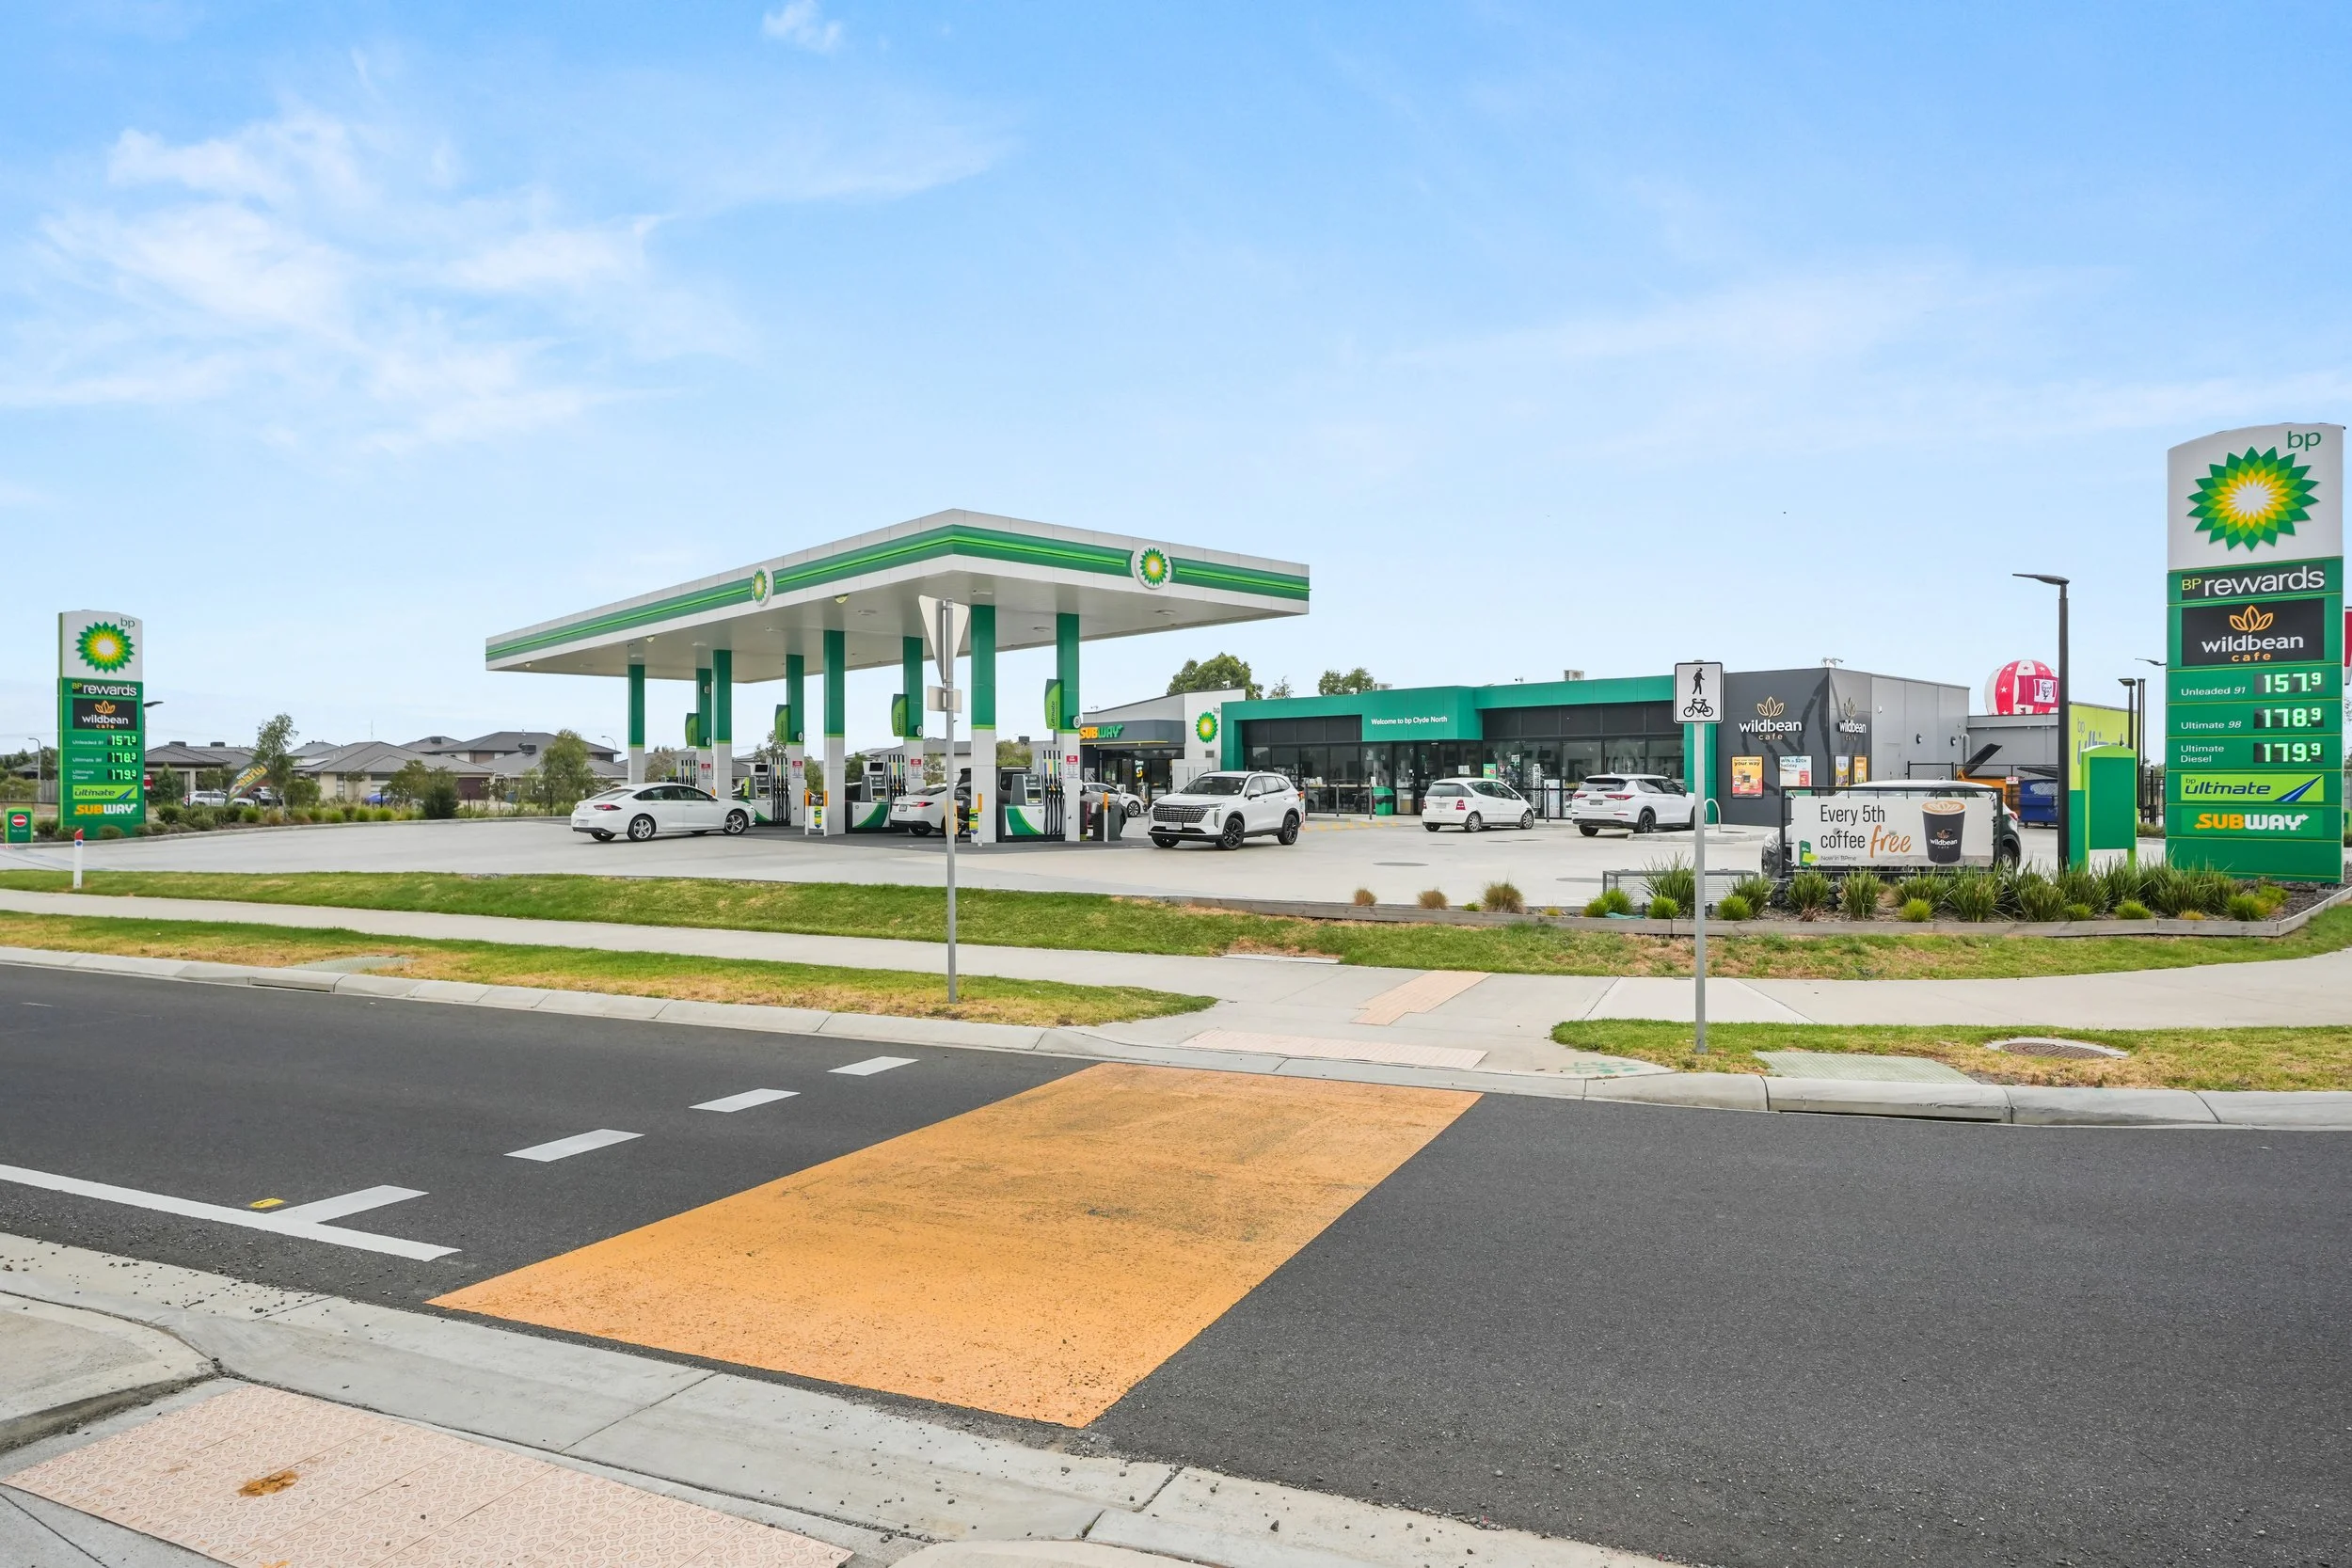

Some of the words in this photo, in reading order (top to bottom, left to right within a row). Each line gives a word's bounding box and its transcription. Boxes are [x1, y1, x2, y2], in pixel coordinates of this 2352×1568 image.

[2287, 431, 2322, 451] bp
[2182, 578, 2201, 591] BP
[2204, 565, 2326, 596] rewards
[120, 617, 135, 629] bp
[2201, 634, 2304, 653] wildbean
[2232, 652, 2271, 662] cafe
[83, 684, 137, 696] rewards
[2181, 688, 2231, 697] Unleaded
[81, 714, 129, 724] wildbean
[1405, 717, 1412, 725] bp
[1412, 716, 1430, 724] Clyde
[1079, 724, 1123, 738] SUBWAY
[1739, 719, 1803, 733] wildbean
[1839, 719, 1867, 734] wildbean
[2181, 721, 2225, 730] Ultimate
[2228, 721, 2242, 729] 98
[2181, 744, 2224, 752] Ultimate
[2181, 754, 2212, 763] Diesel
[74, 788, 116, 797] ultimate
[2185, 782, 2272, 795] ultimate
[74, 803, 137, 815] SUBWAY
[1820, 804, 1858, 826] Every
[1863, 804, 1885, 822] 5th
[2194, 814, 2310, 831] SUBWAY
[1820, 831, 1866, 848] coffee
[1869, 824, 1912, 859] free
